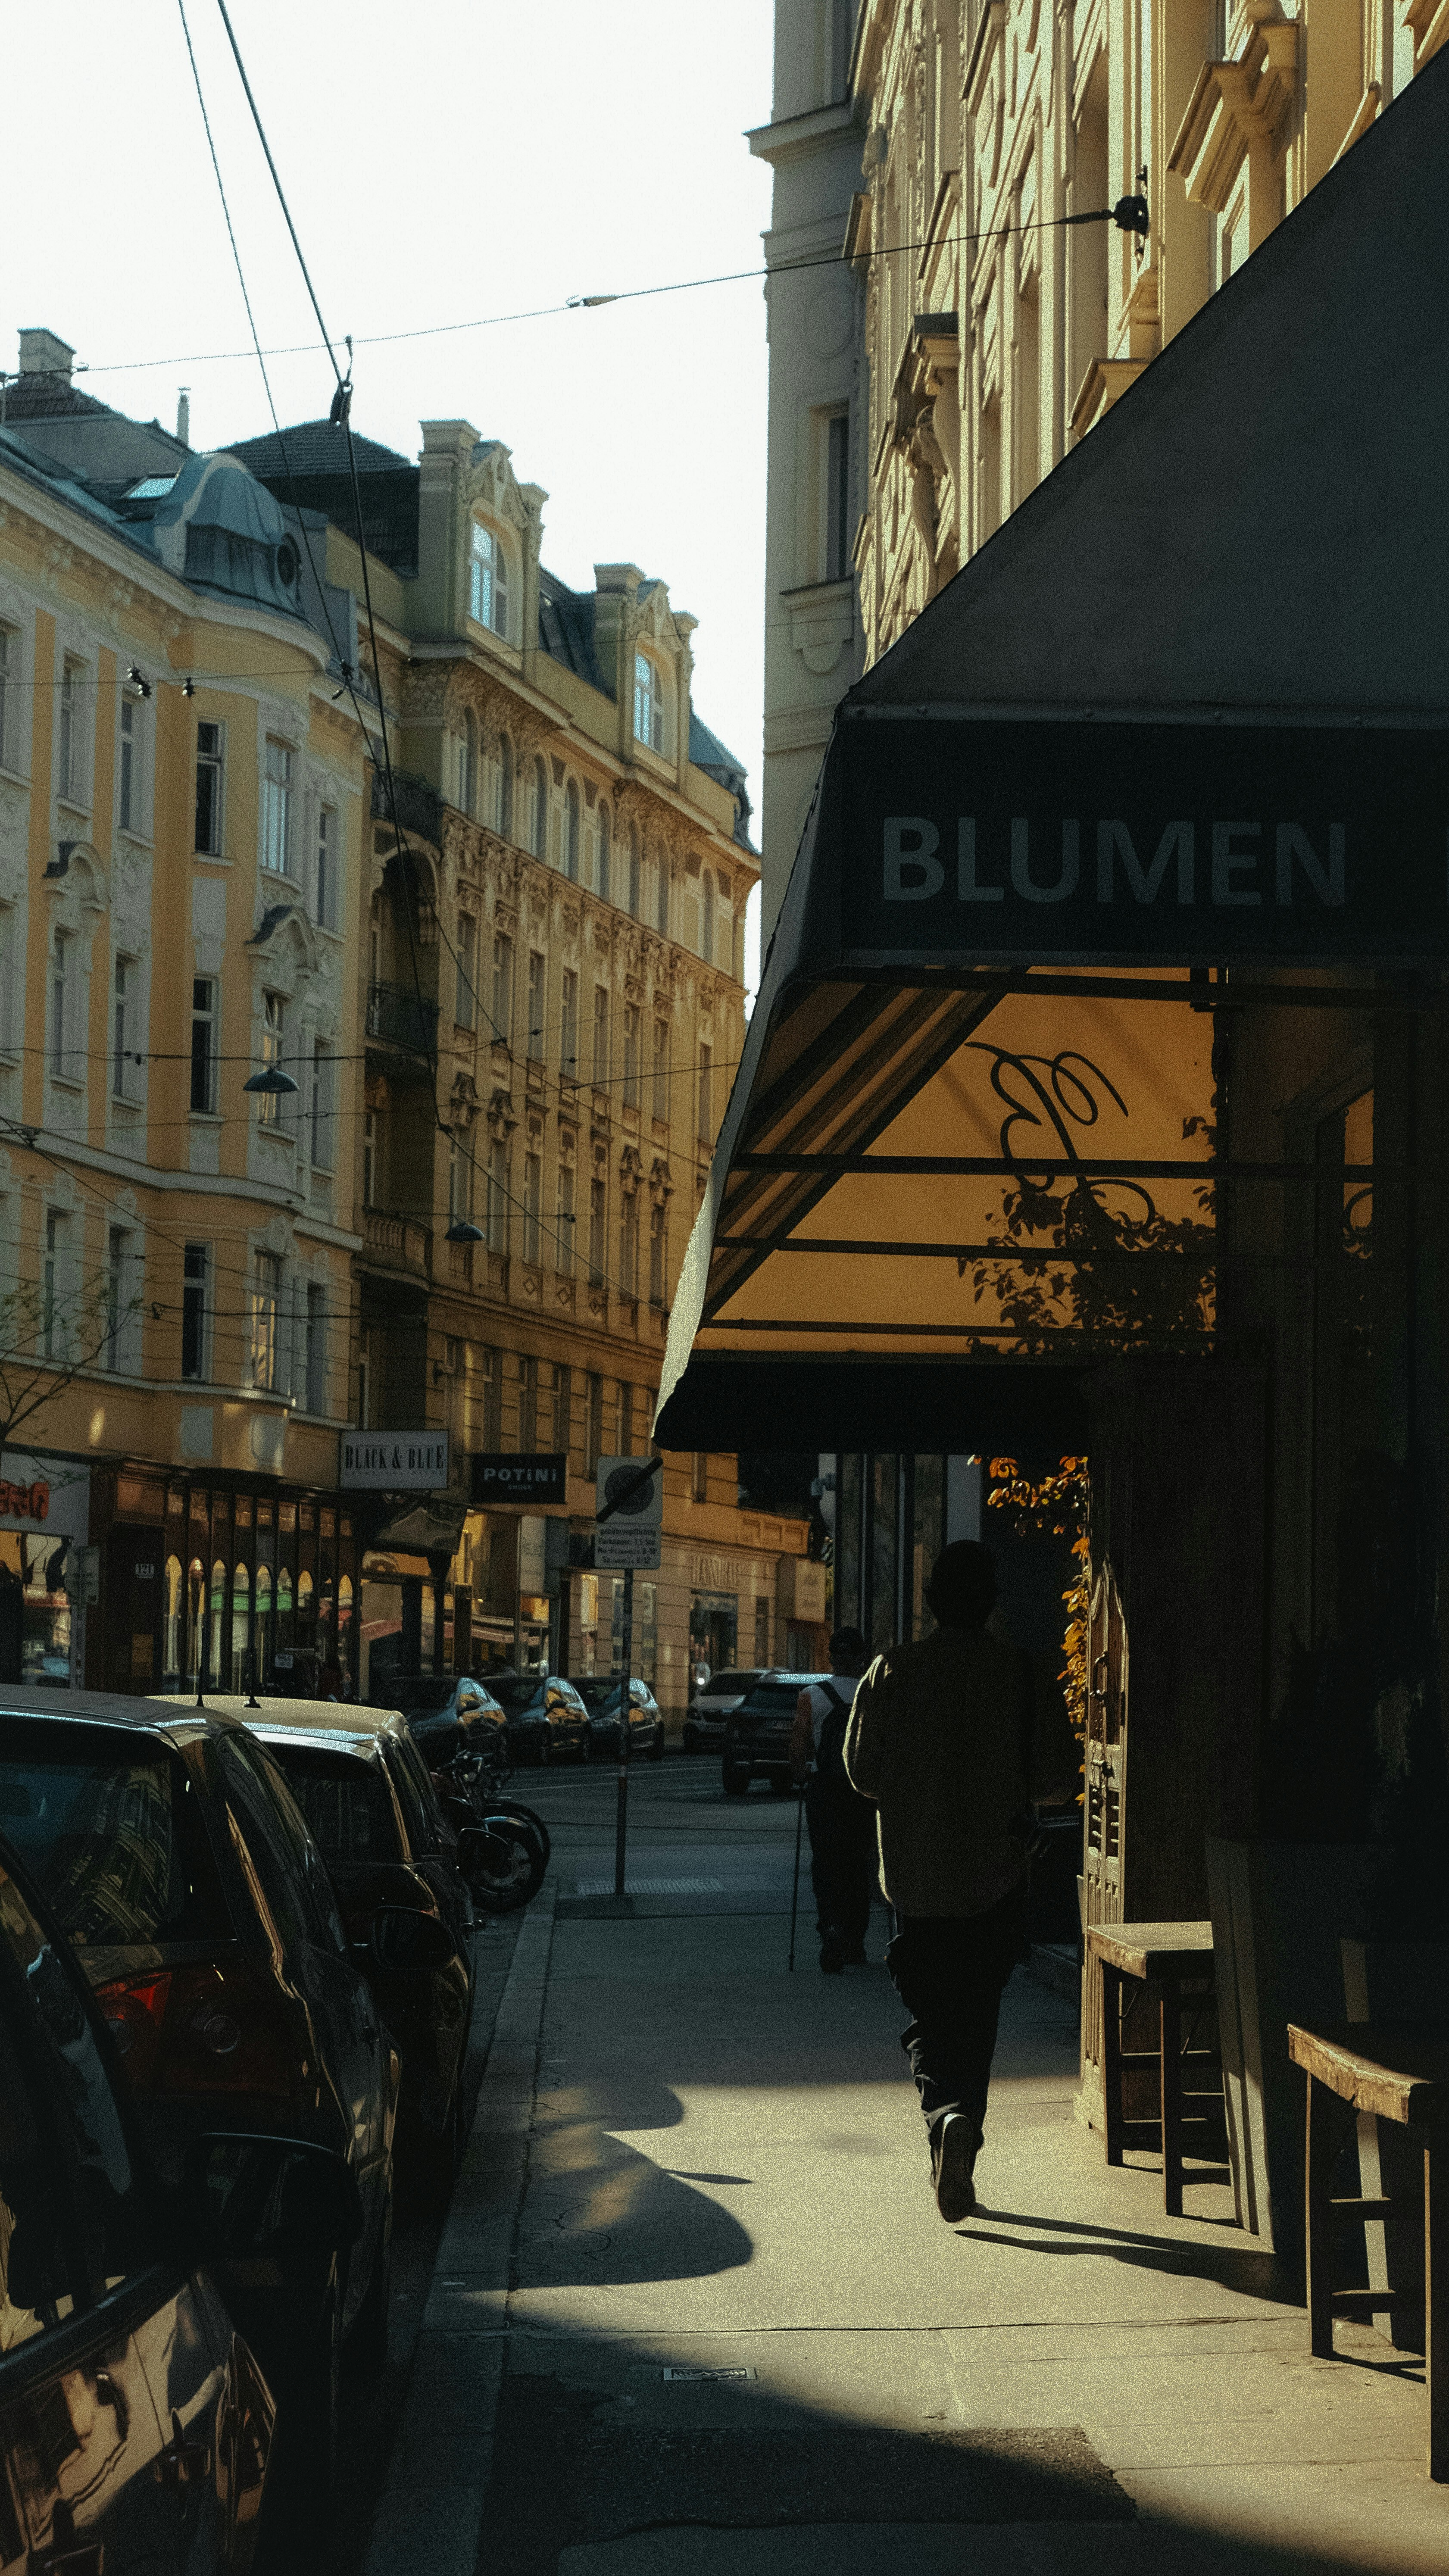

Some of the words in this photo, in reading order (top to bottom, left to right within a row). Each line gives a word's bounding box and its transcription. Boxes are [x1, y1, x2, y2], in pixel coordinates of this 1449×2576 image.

[883, 817, 1346, 906] BLUMEN
[346, 1445, 386, 1468] BLACK
[392, 1445, 402, 1468] &
[409, 1445, 443, 1468] BLUE
